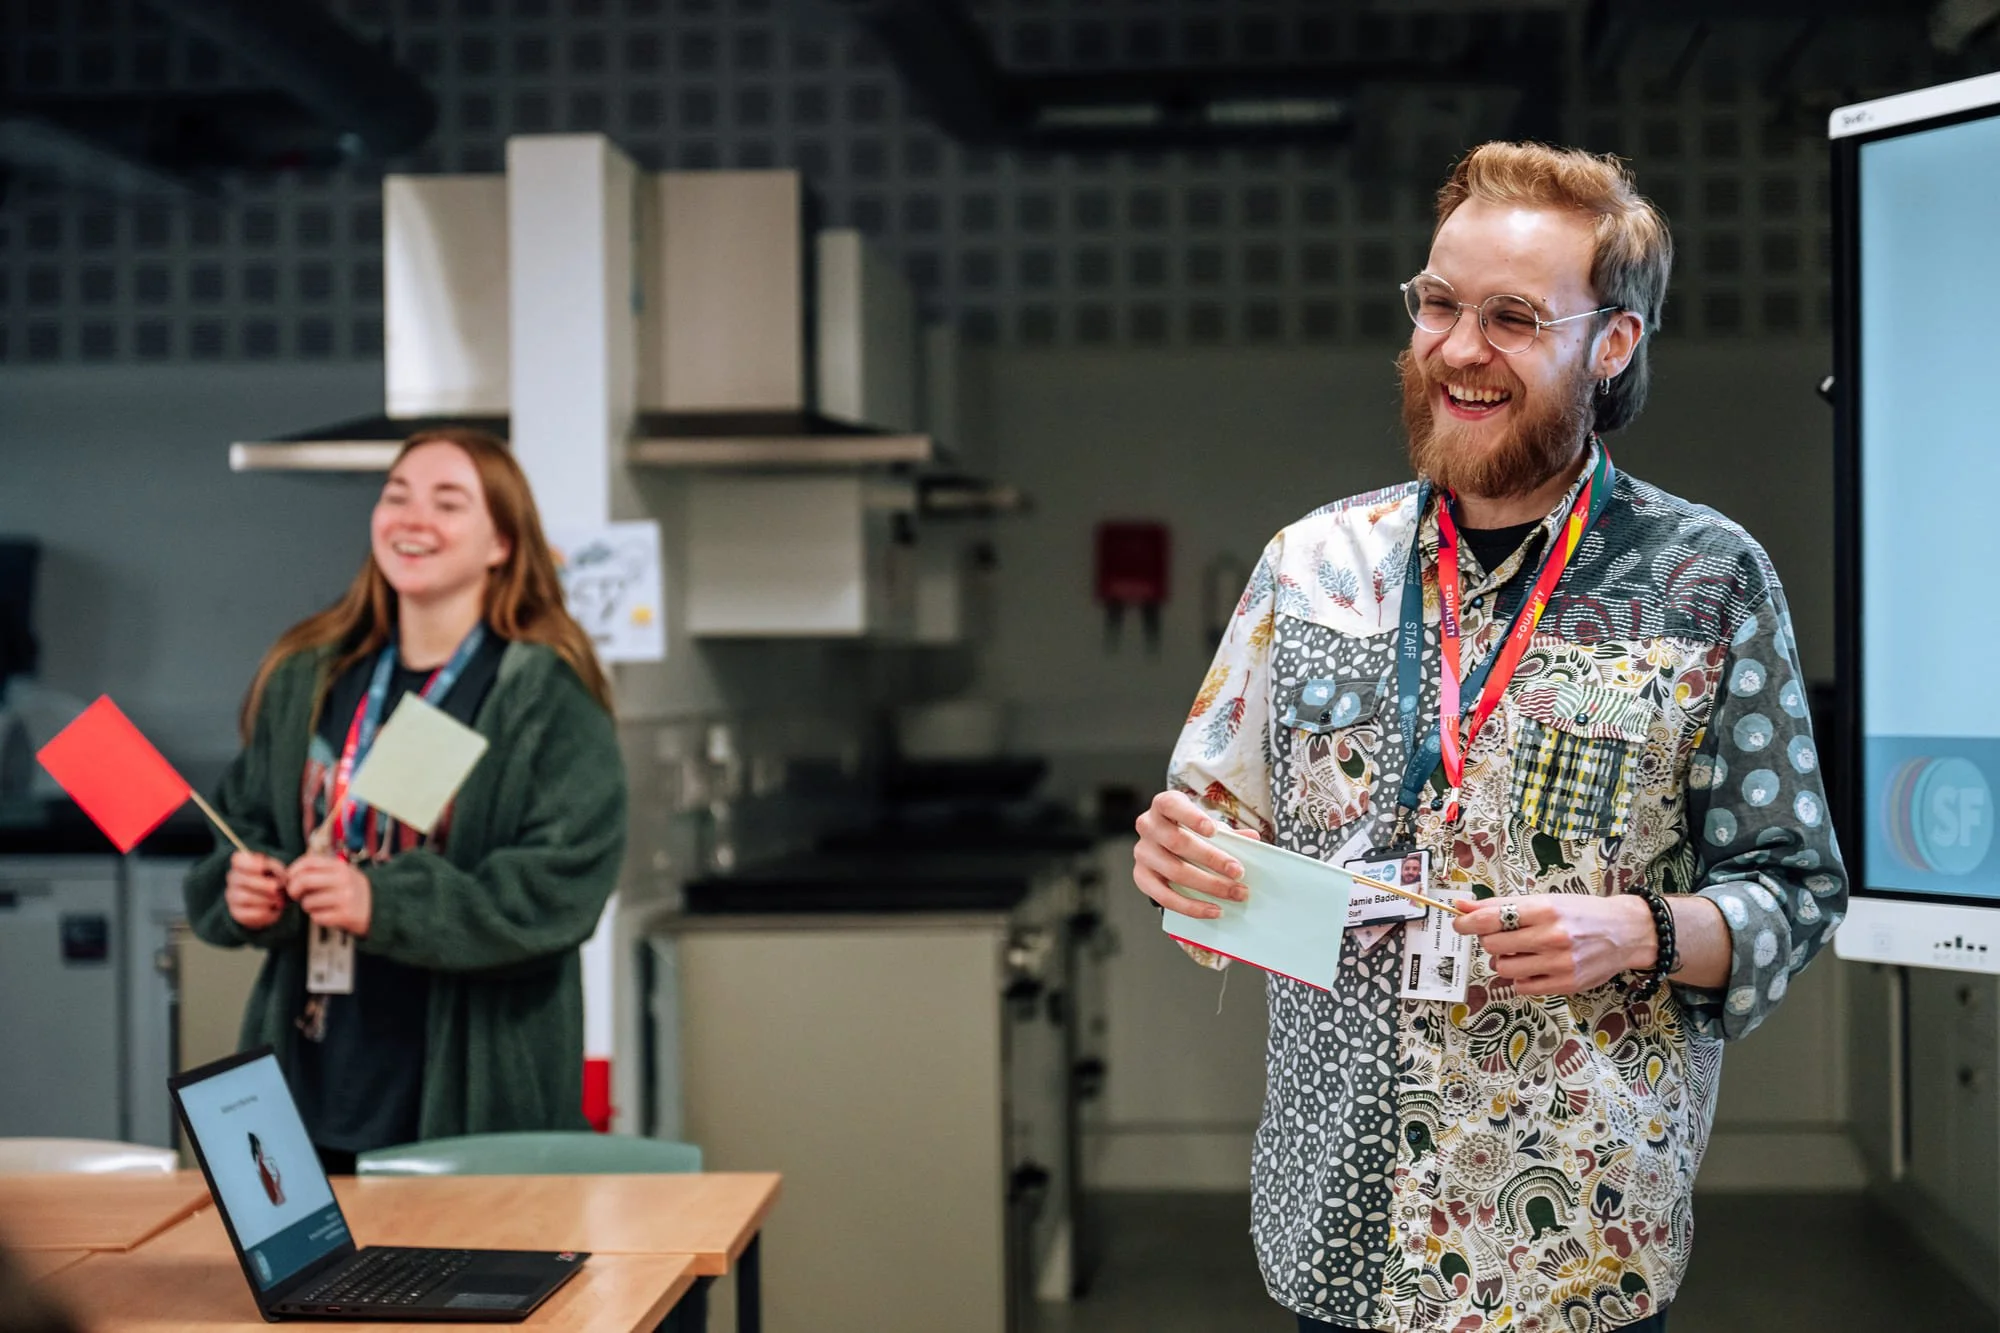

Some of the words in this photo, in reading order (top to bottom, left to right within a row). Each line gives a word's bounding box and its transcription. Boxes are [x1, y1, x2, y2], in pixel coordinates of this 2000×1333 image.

[1403, 621, 1417, 659] STAFF
[1931, 786, 1985, 848] SF
[1348, 896, 1373, 907] Jamie
